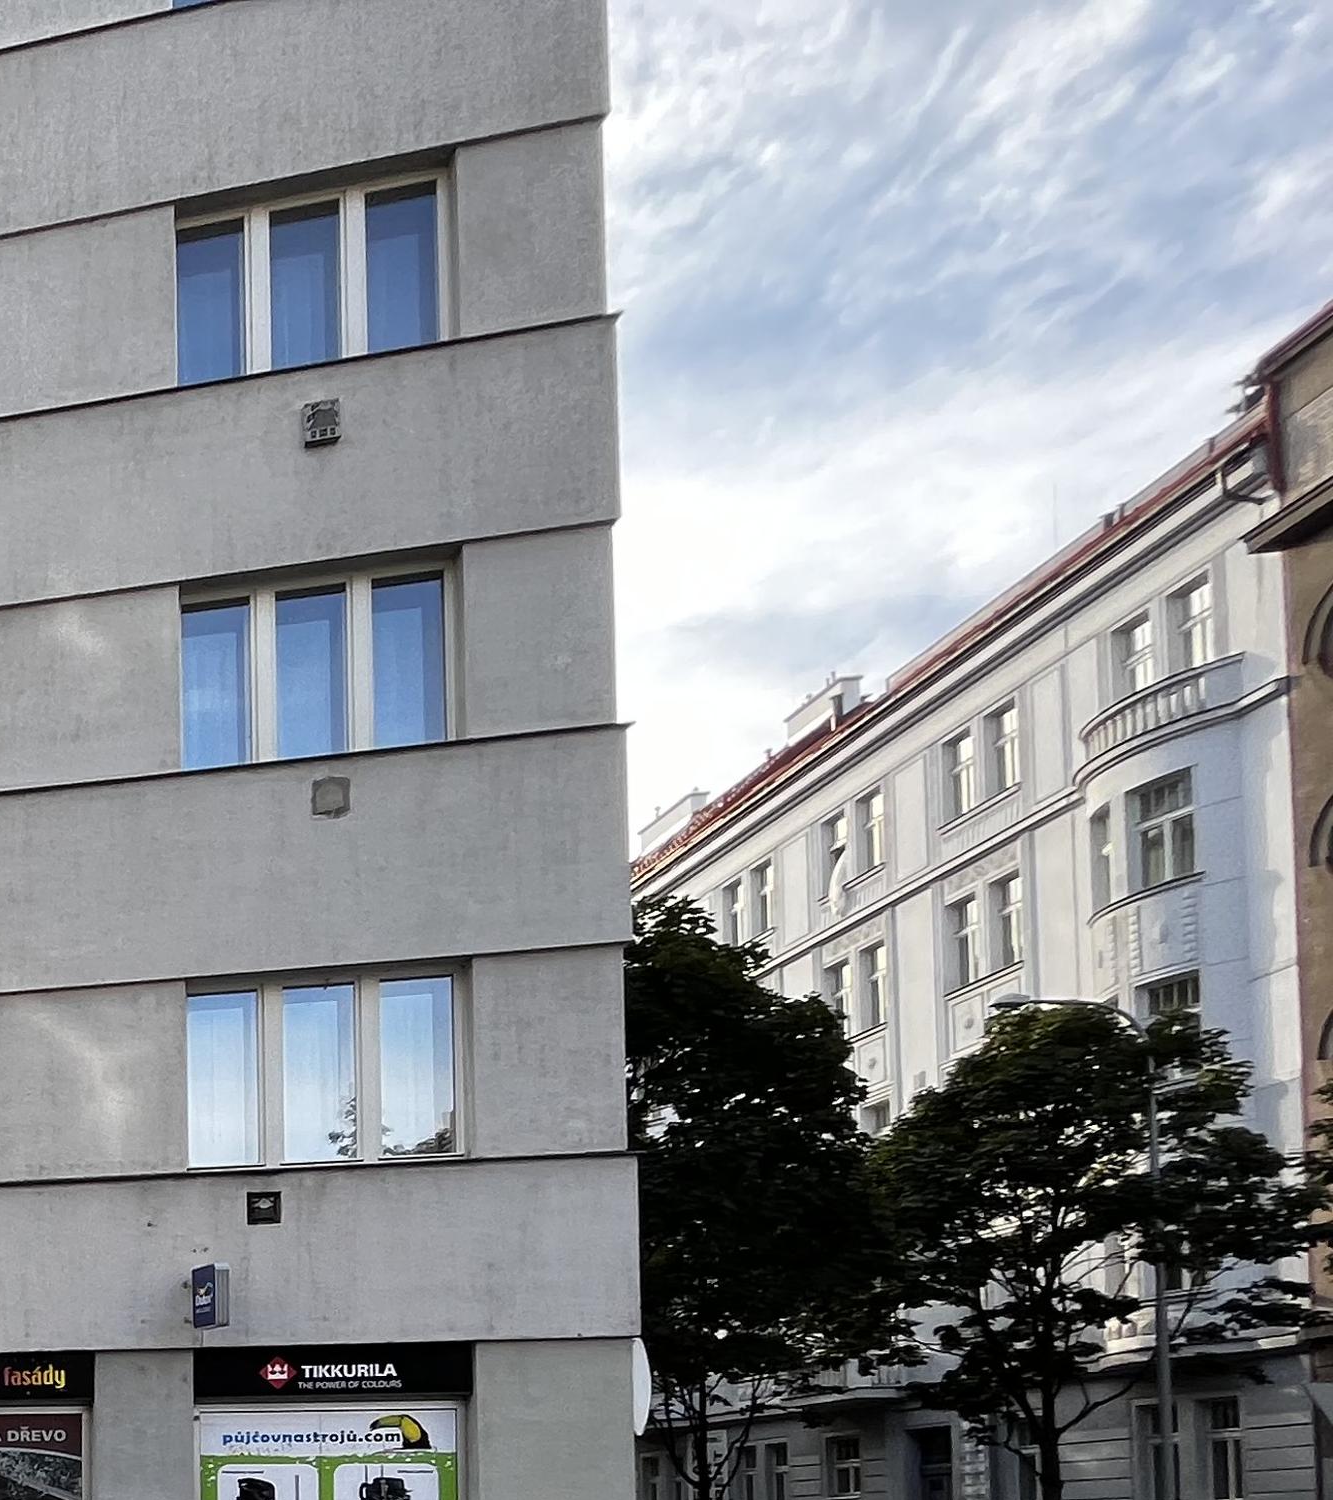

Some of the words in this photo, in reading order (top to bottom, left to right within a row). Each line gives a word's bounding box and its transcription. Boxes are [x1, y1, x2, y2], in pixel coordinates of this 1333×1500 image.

[3, 1364, 66, 1389] fasády
[301, 1364, 397, 1378] TIKKURILA
[298, 1381, 314, 1389] THE
[315, 1381, 346, 1389] POWER
[7, 1425, 67, 1442] DŘEVO
[223, 1430, 401, 1445] půjčovnastrojů.com
